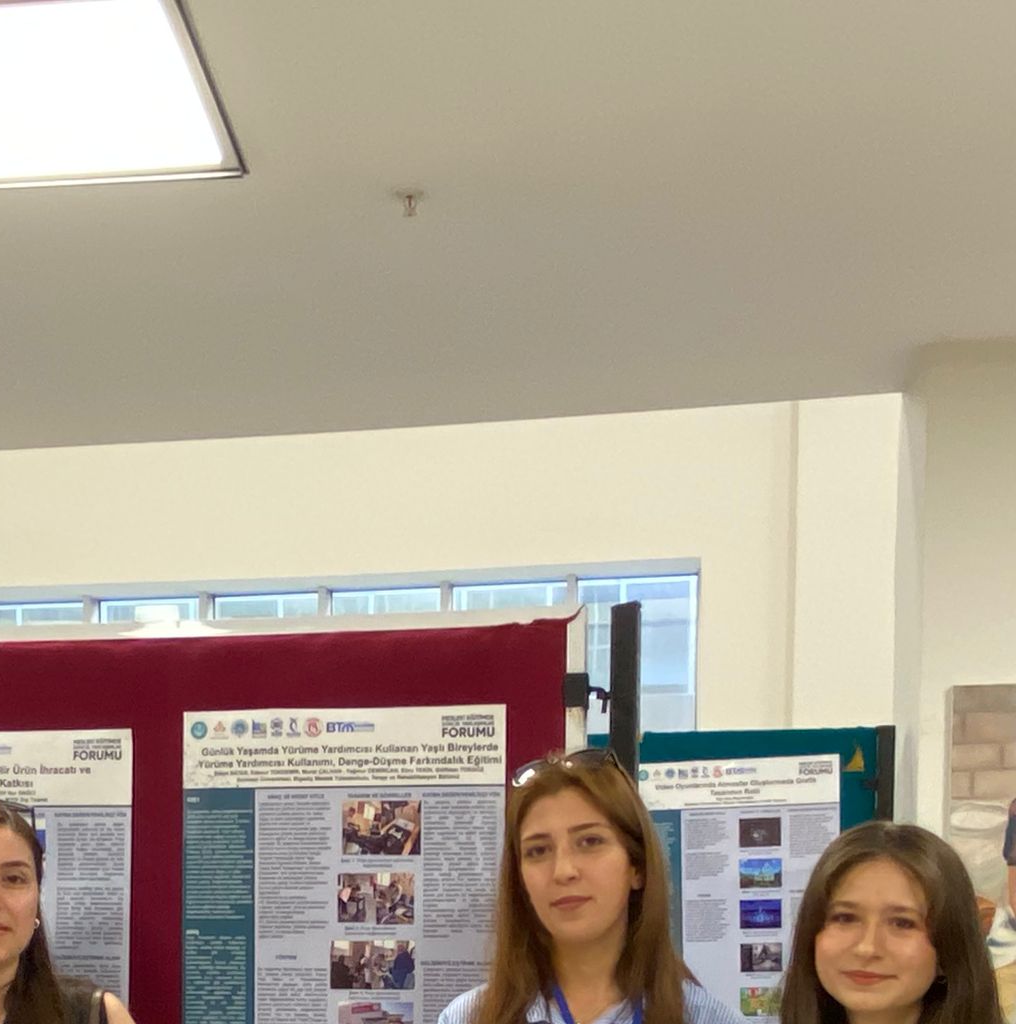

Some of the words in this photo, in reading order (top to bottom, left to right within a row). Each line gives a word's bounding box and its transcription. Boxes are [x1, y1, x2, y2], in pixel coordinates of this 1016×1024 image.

[441, 727, 496, 738] FORUMU
[201, 747, 234, 757] Günlük
[237, 746, 279, 757] Yaşamda
[282, 745, 319, 754] Yürüme
[321, 744, 372, 754] Yardımcısı
[375, 744, 419, 753] Kullanan
[421, 743, 445, 754] Yaşlı
[447, 742, 499, 753] Bireylerde
[73, 750, 122, 761] FORUMU
[198, 759, 233, 769] Yürüme
[236, 758, 284, 768] Yardımcısı
[287, 757, 336, 767] Kullanımı,
[338, 756, 407, 767] Denge-Düşme
[409, 755, 464, 765] Farkındalık
[467, 754, 503, 767] Eğitimi
[12, 764, 37, 775] Ürün
[39, 764, 76, 775] İhracatı
[0, 778, 33, 788] Katkısı
